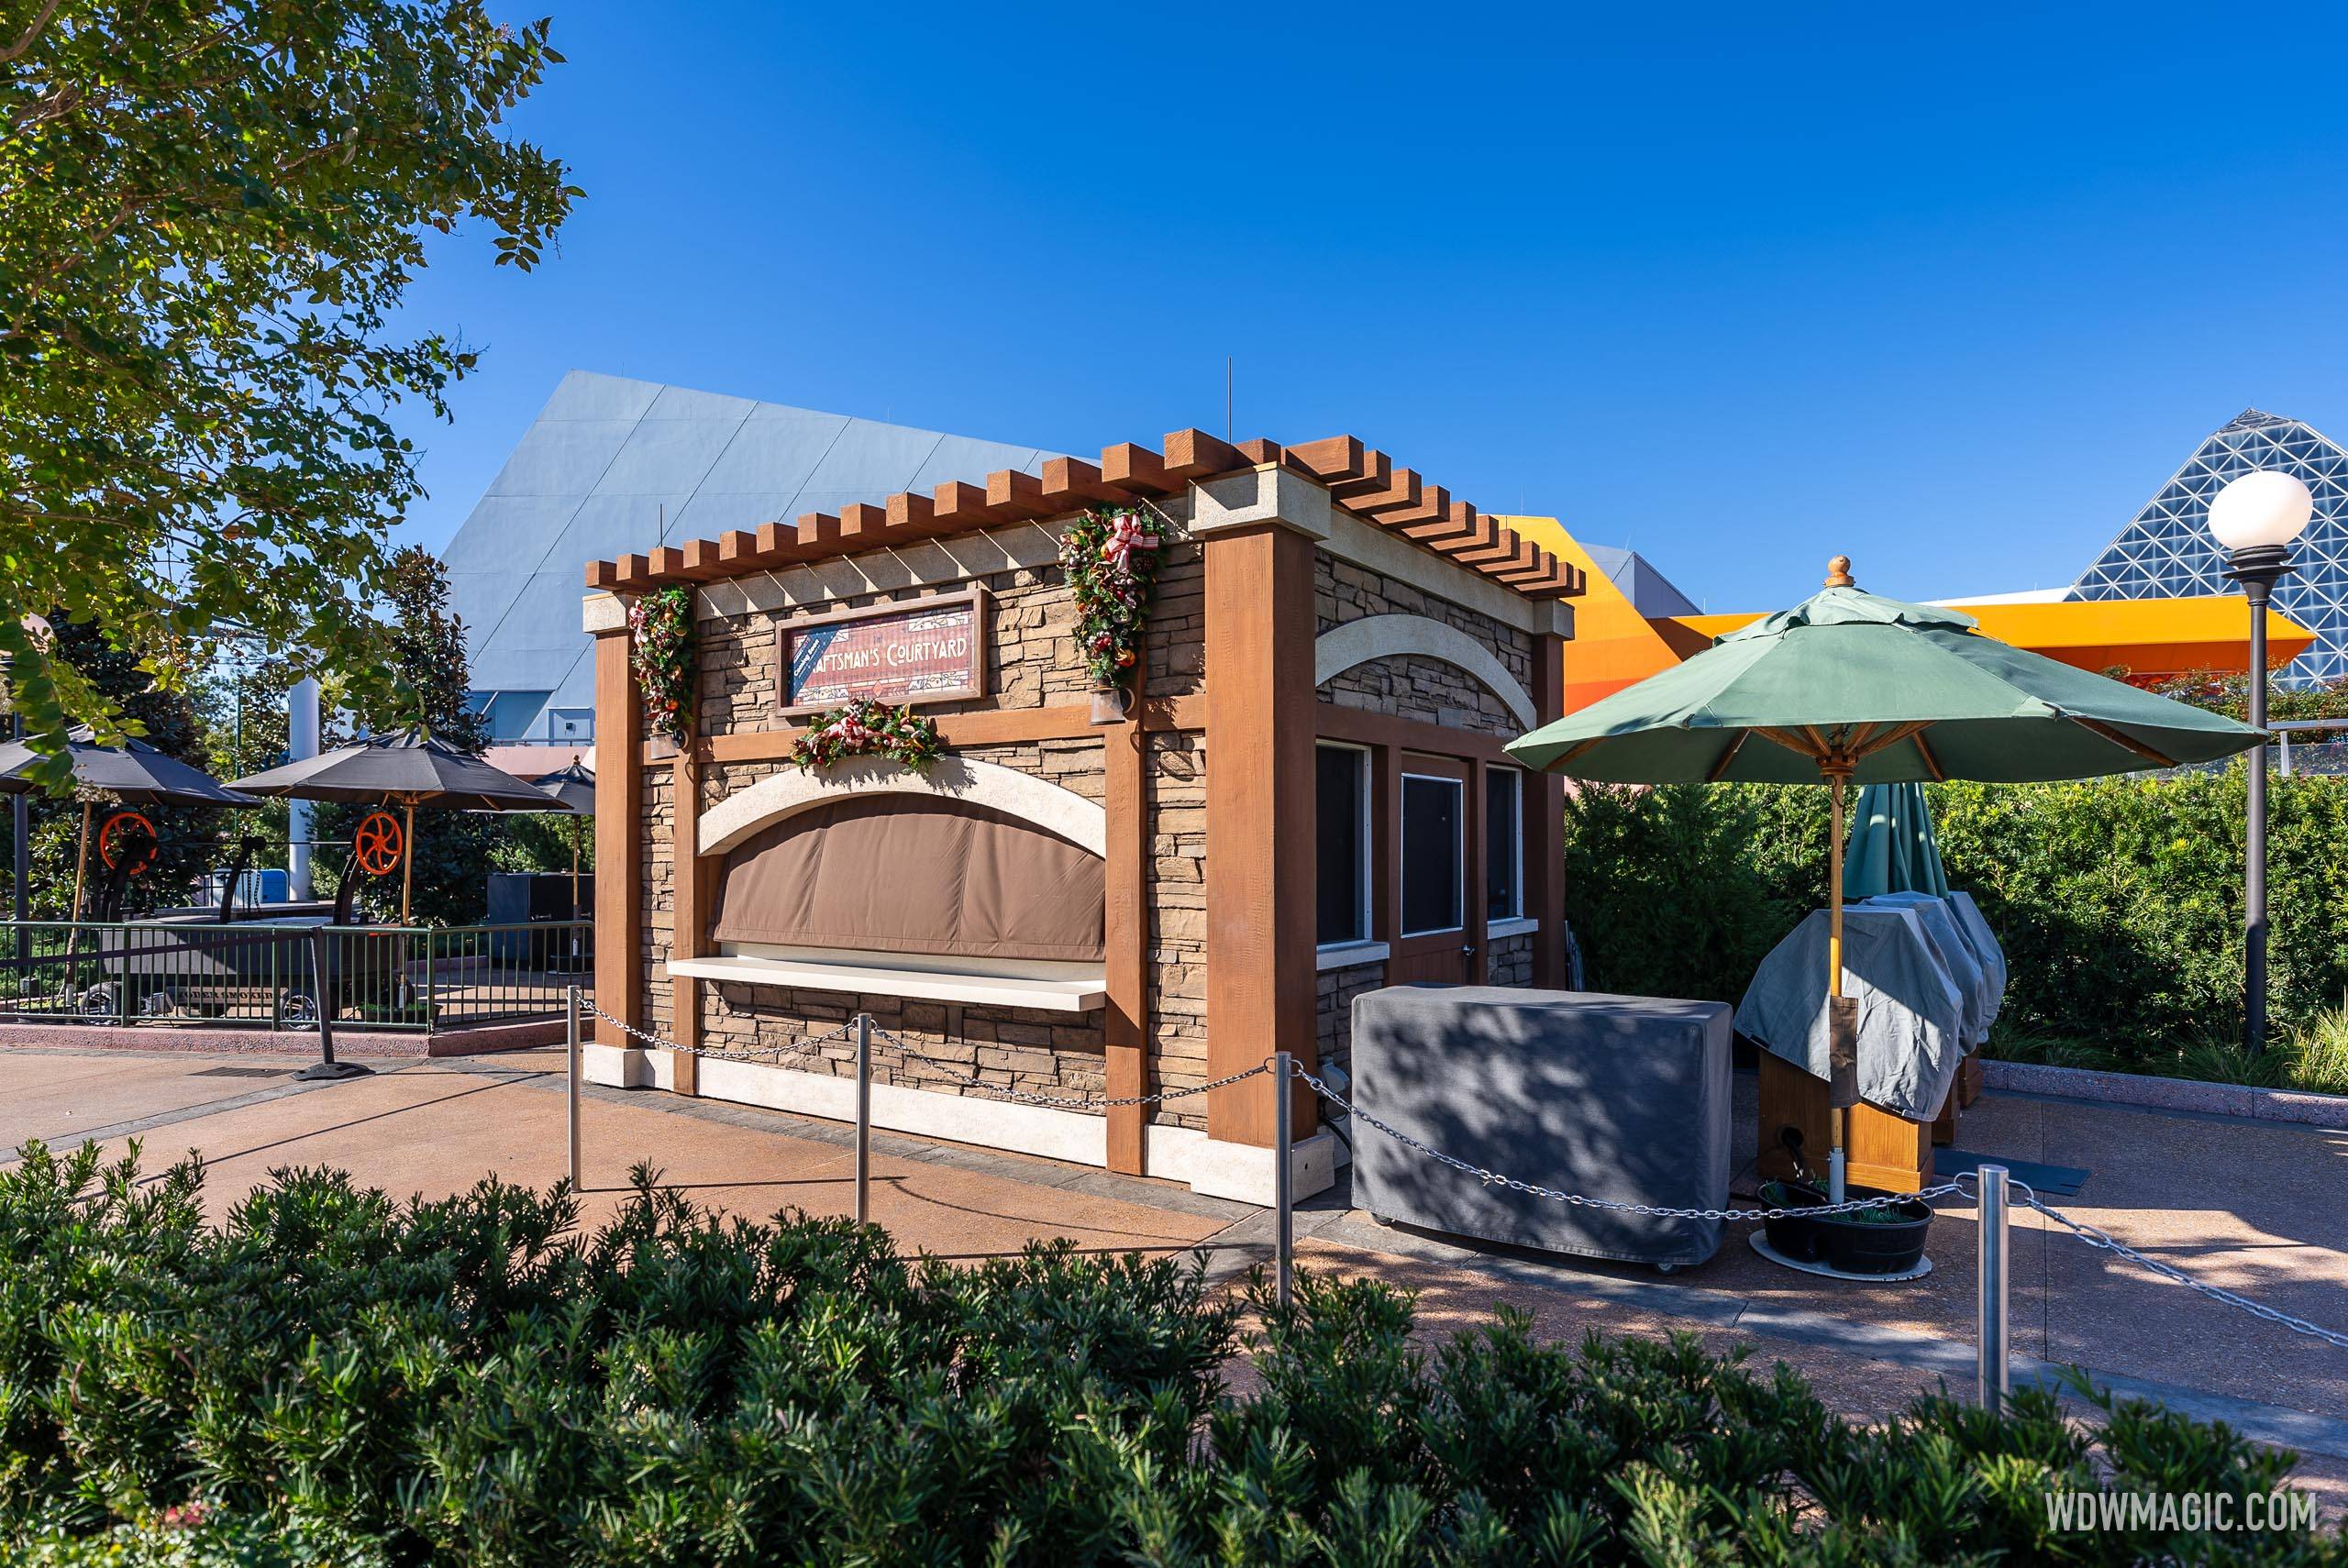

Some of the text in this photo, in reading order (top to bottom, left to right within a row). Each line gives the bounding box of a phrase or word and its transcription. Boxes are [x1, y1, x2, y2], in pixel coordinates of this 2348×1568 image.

[793, 654, 811, 677] Coming
[807, 638, 820, 655] Soon
[813, 647, 880, 674] AFTSMAN'S
[887, 637, 968, 667] COURTYARD
